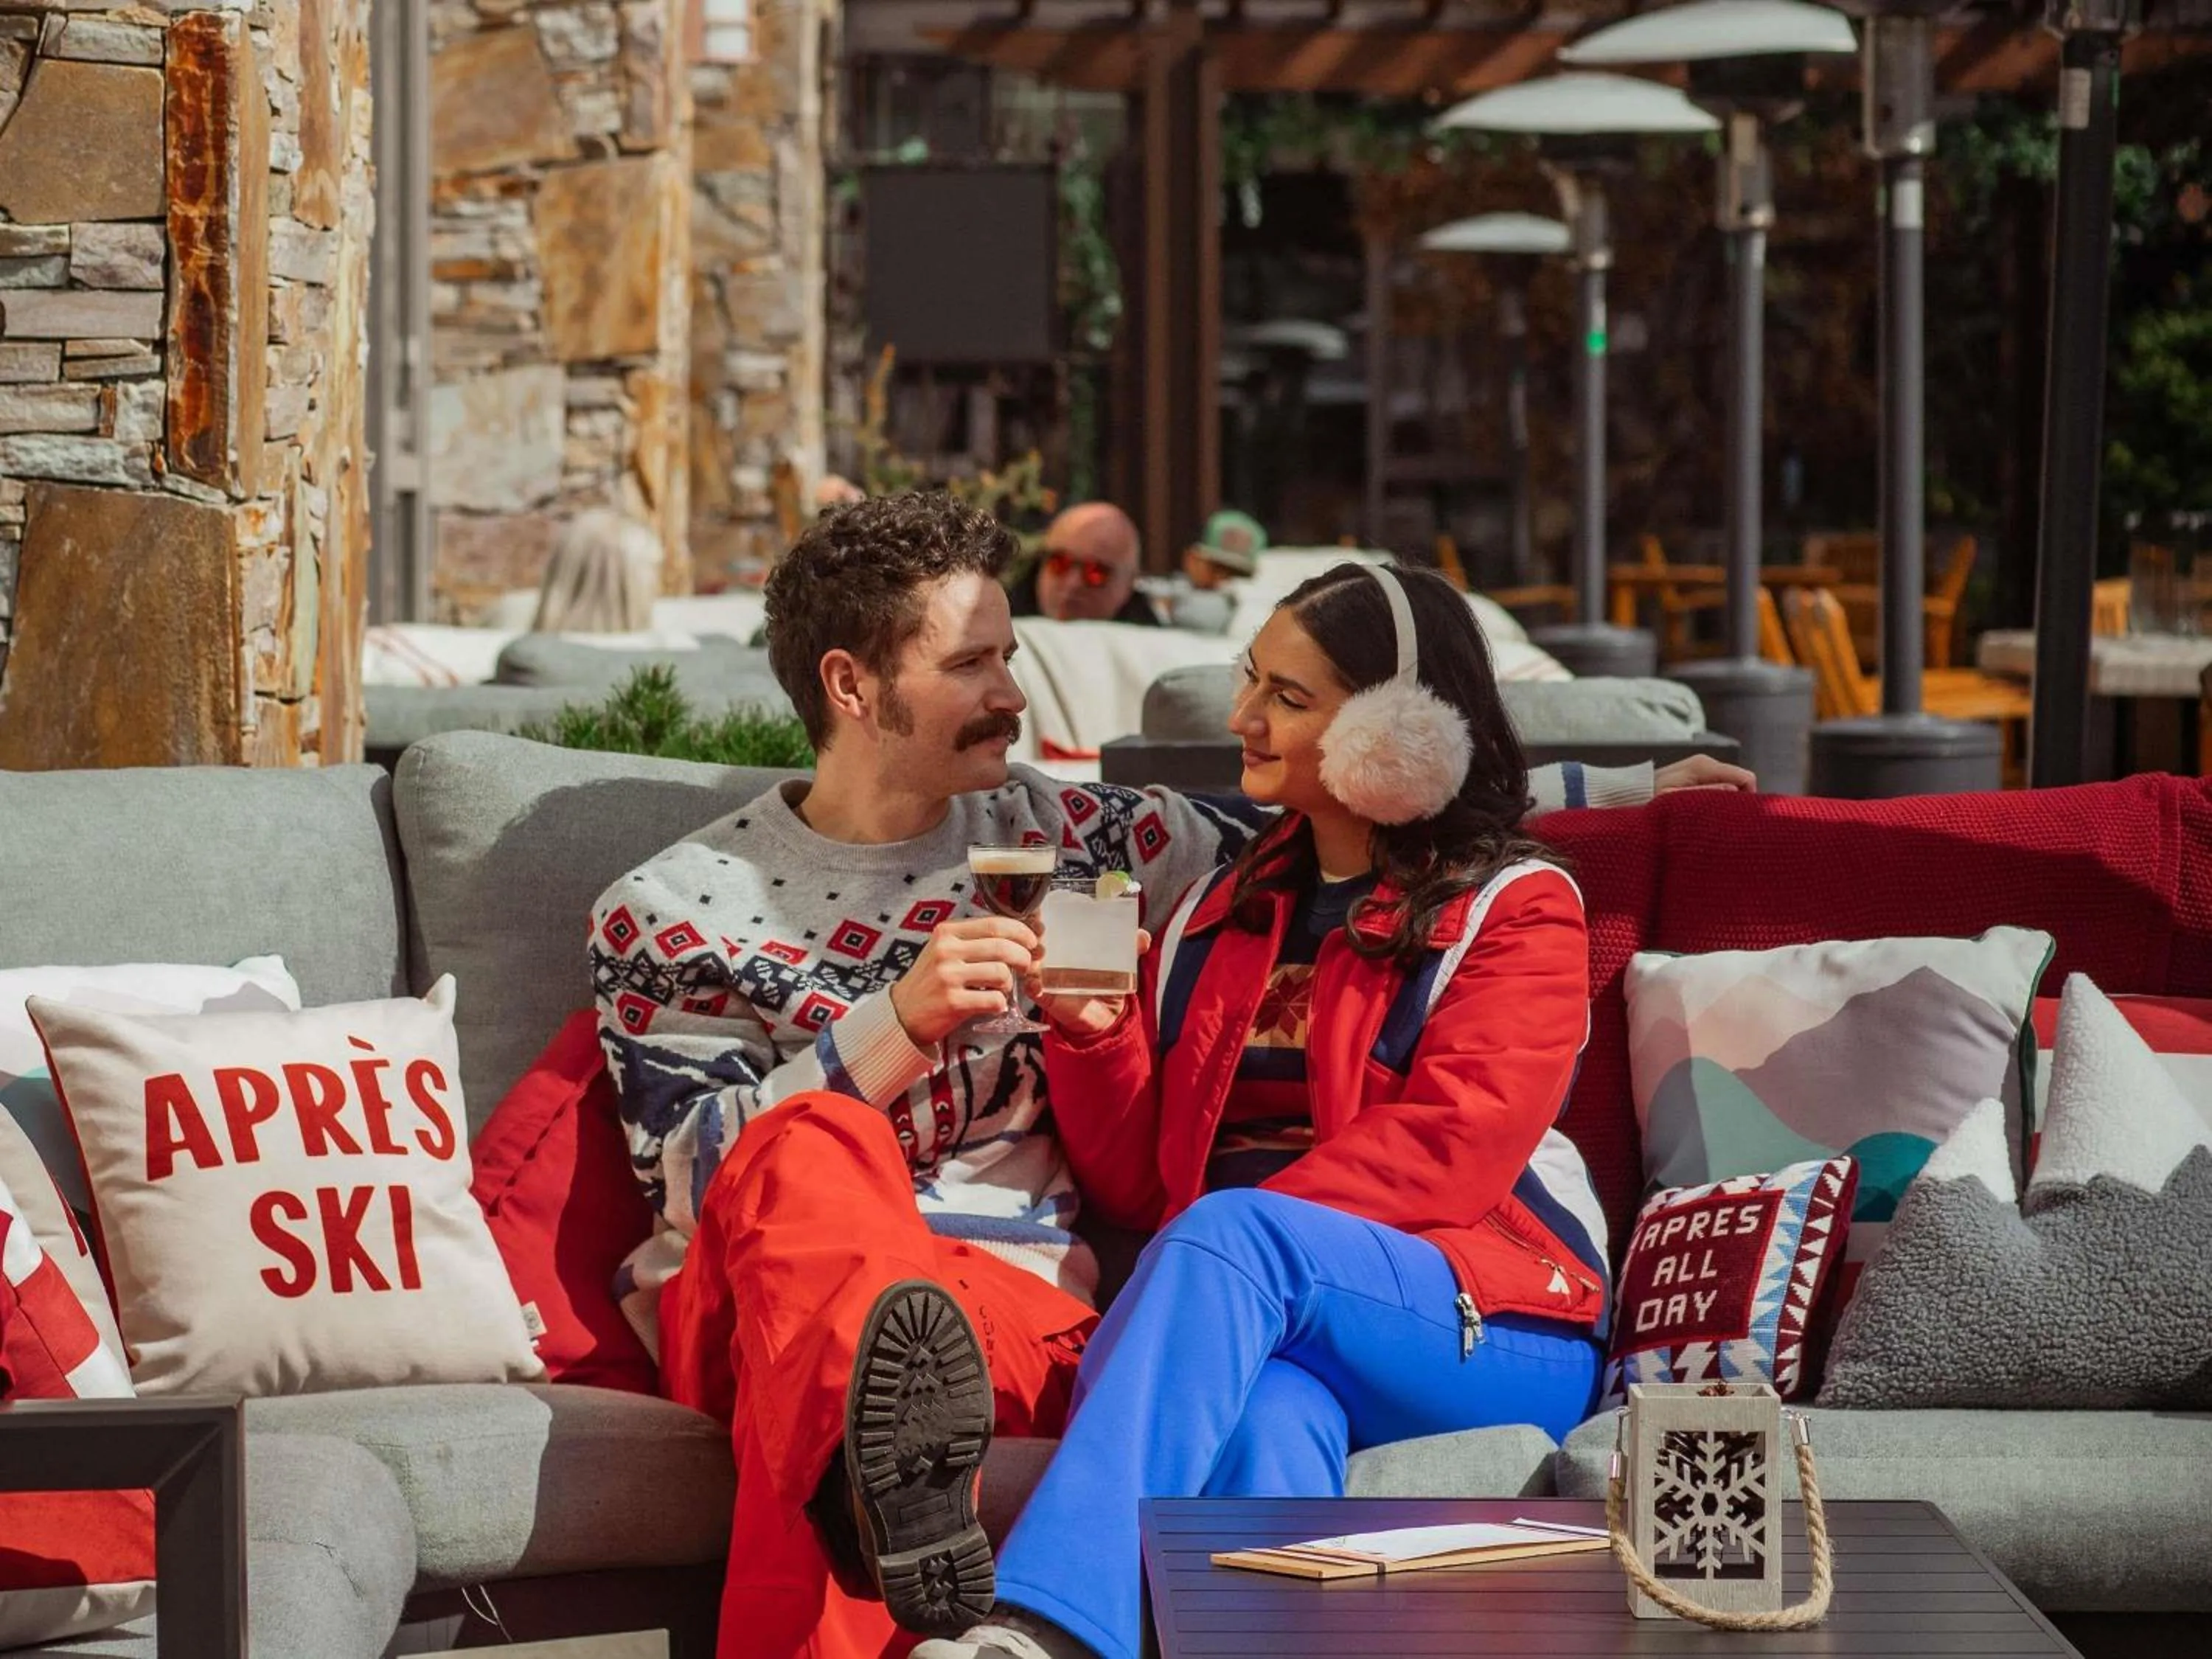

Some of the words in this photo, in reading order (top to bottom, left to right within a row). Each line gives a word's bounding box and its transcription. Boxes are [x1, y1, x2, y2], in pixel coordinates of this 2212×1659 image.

[145, 1034, 456, 1181] APRÈS
[250, 1185, 422, 1298] SKI
[1639, 1205, 1763, 1251] APRES
[1652, 1249, 1718, 1287] ALL
[1635, 1290, 1718, 1332] DAY
